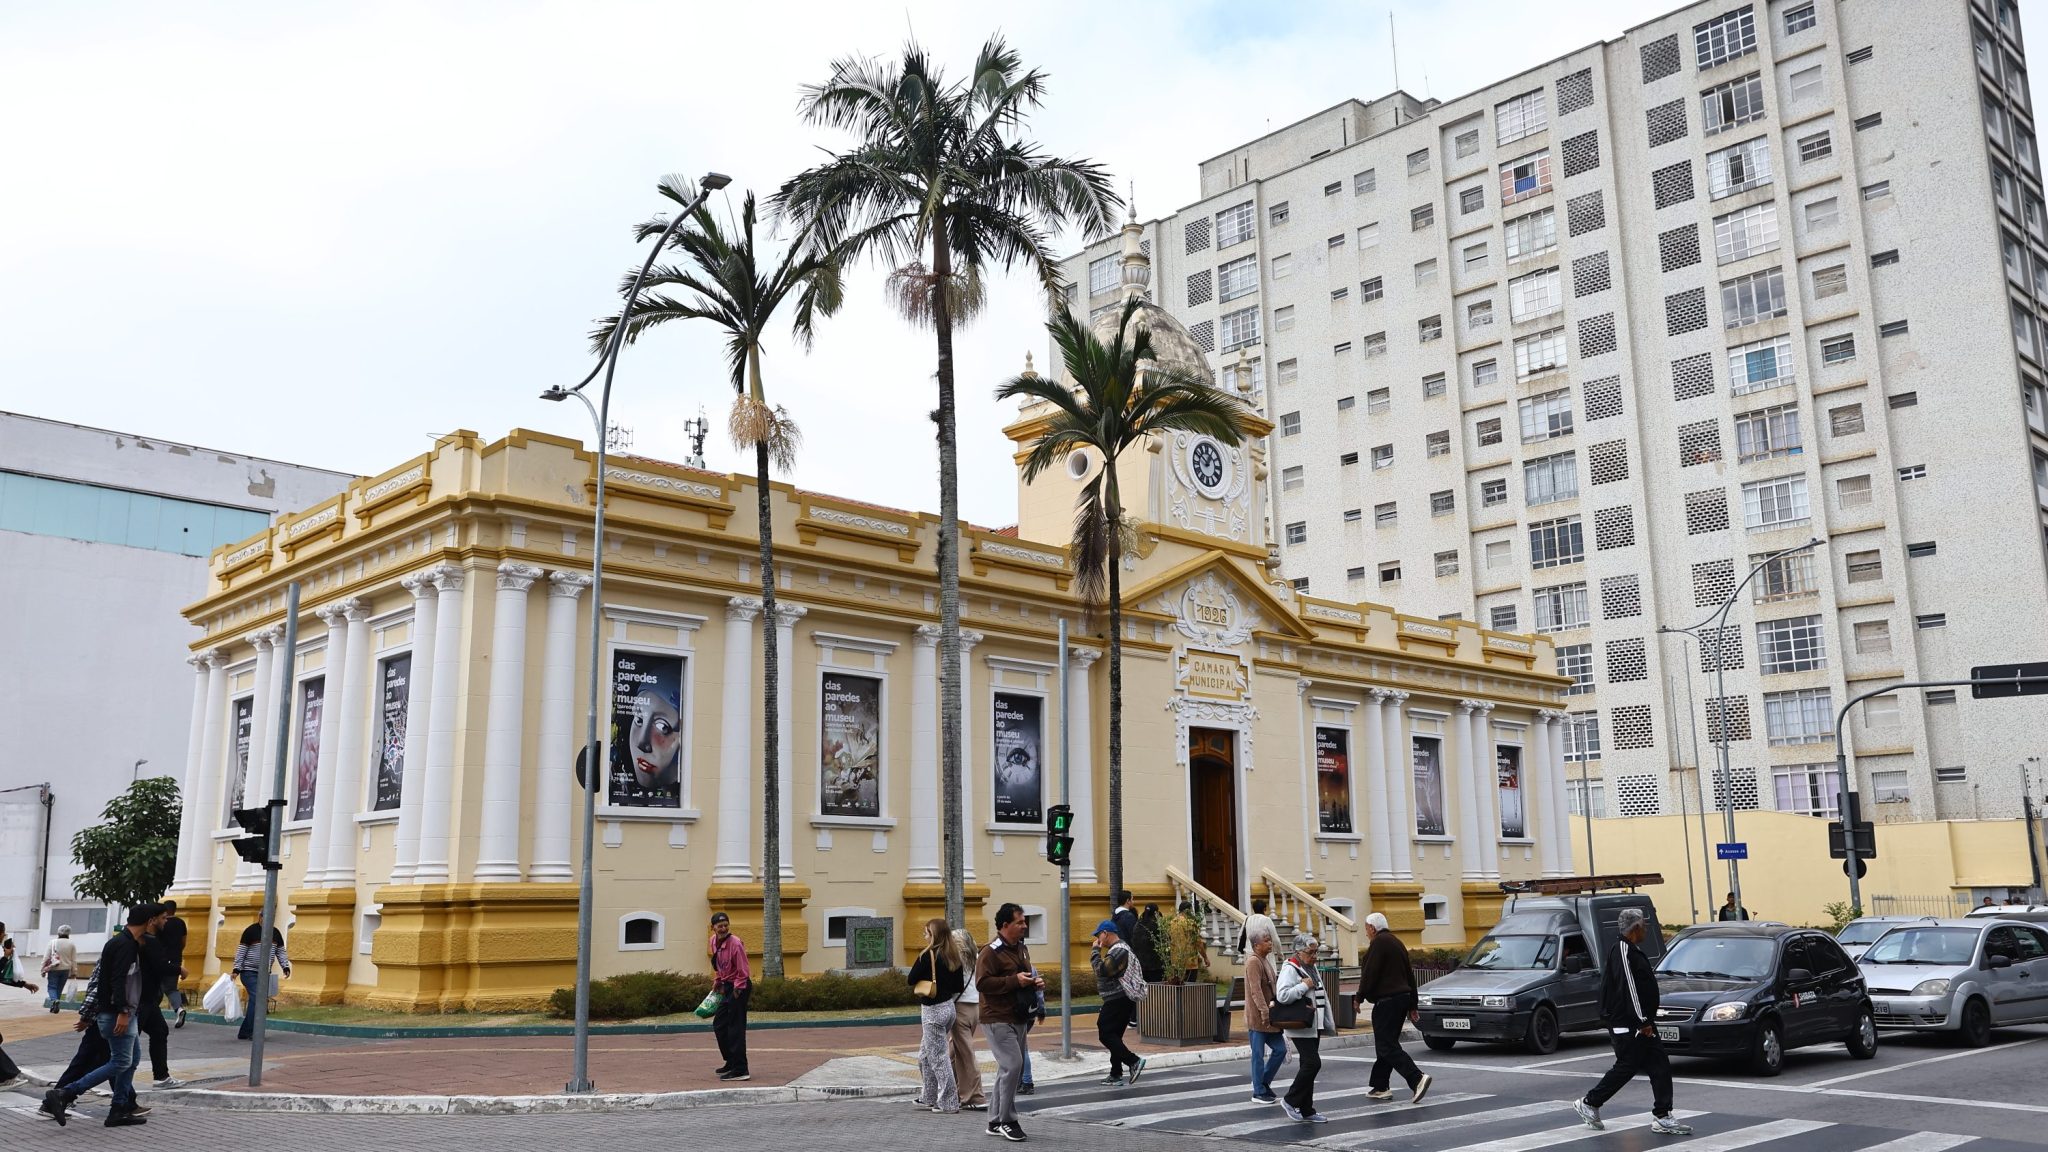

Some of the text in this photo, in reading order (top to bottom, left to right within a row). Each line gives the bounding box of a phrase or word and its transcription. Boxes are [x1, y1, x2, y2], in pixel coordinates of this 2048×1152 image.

[1196, 606, 1227, 623] 1926
[618, 659, 636, 670] das
[617, 672, 658, 684] paredes
[1189, 675, 1237, 691] MUNICIPAL
[617, 683, 630, 692] ao
[825, 680, 841, 691] das
[617, 694, 650, 706] museu
[824, 692, 860, 703] paredes
[824, 703, 837, 711] ao
[995, 700, 1008, 709] das
[824, 713, 855, 723] museu
[995, 711, 1024, 720] paredes
[995, 730, 1020, 739] museu
